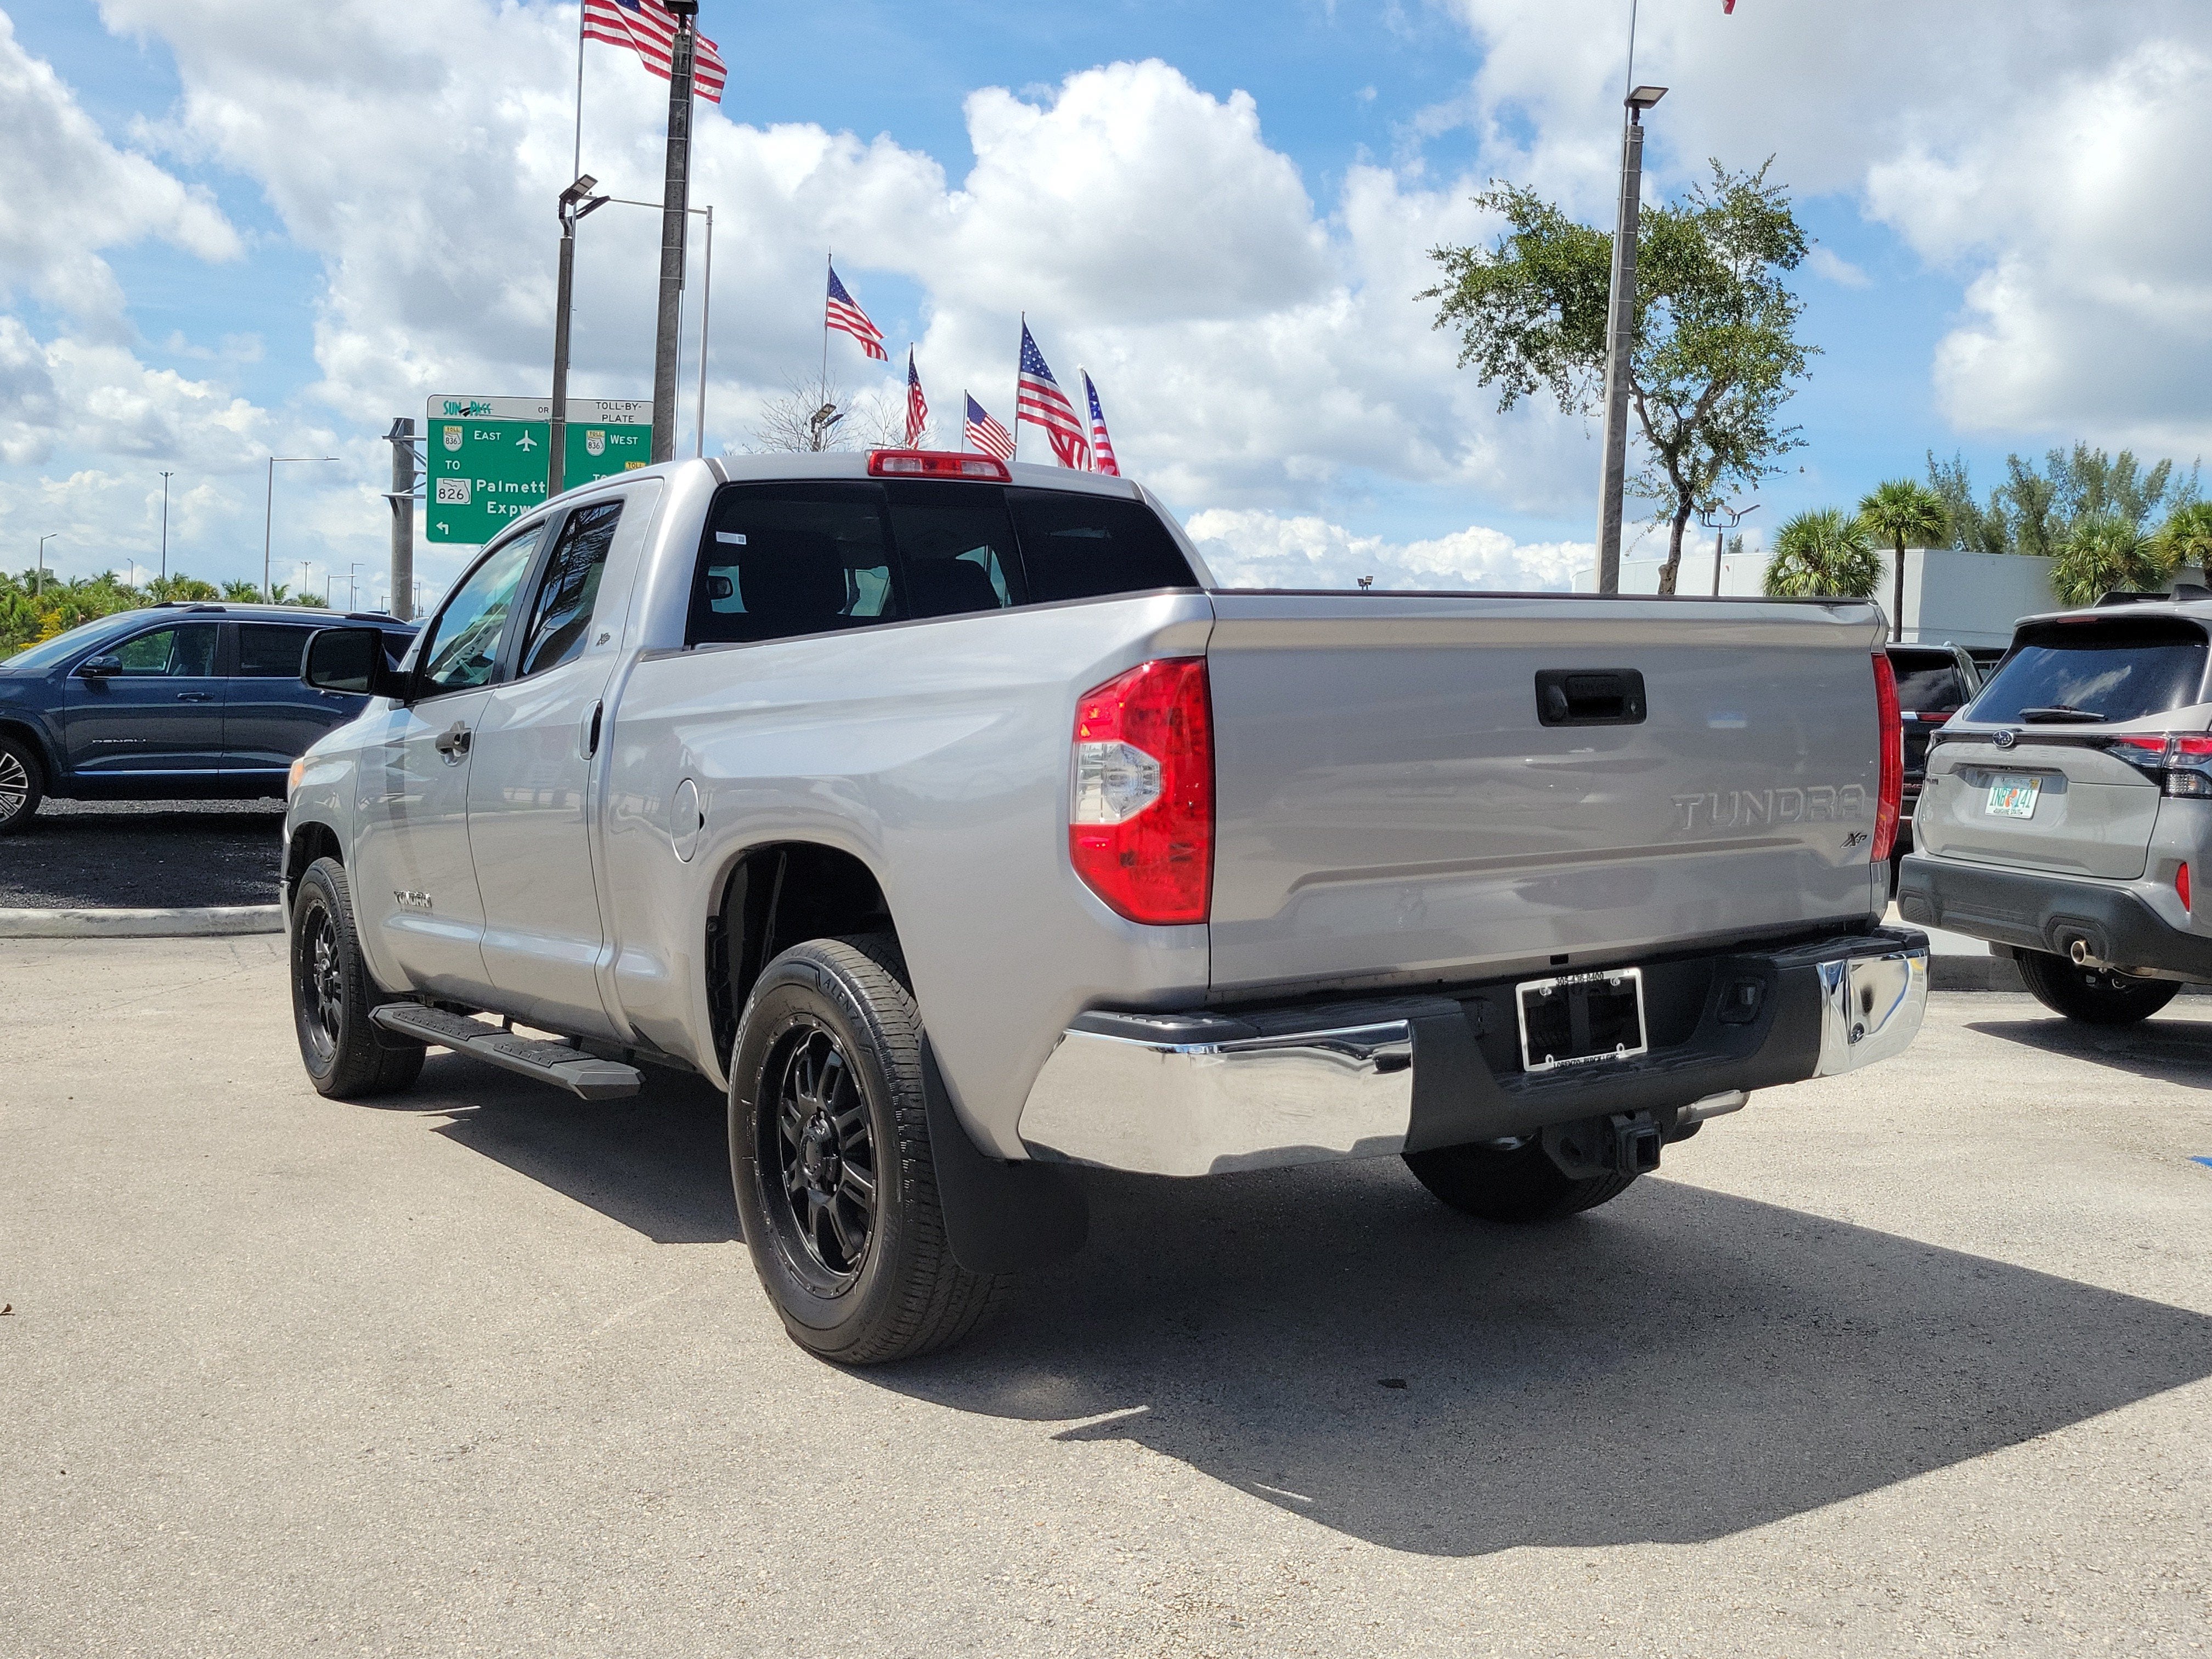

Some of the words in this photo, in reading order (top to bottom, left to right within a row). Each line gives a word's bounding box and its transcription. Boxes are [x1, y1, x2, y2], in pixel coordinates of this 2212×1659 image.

[596, 402, 642, 410] TOLL-BY-
[602, 414, 634, 422] PLATE
[474, 430, 501, 441] EAST
[610, 435, 639, 445] WEST
[445, 460, 461, 470] TO
[476, 479, 546, 493] Palmett
[438, 488, 464, 500] 826
[487, 501, 531, 517] Expw
[1672, 783, 1865, 830] TUNDRA
